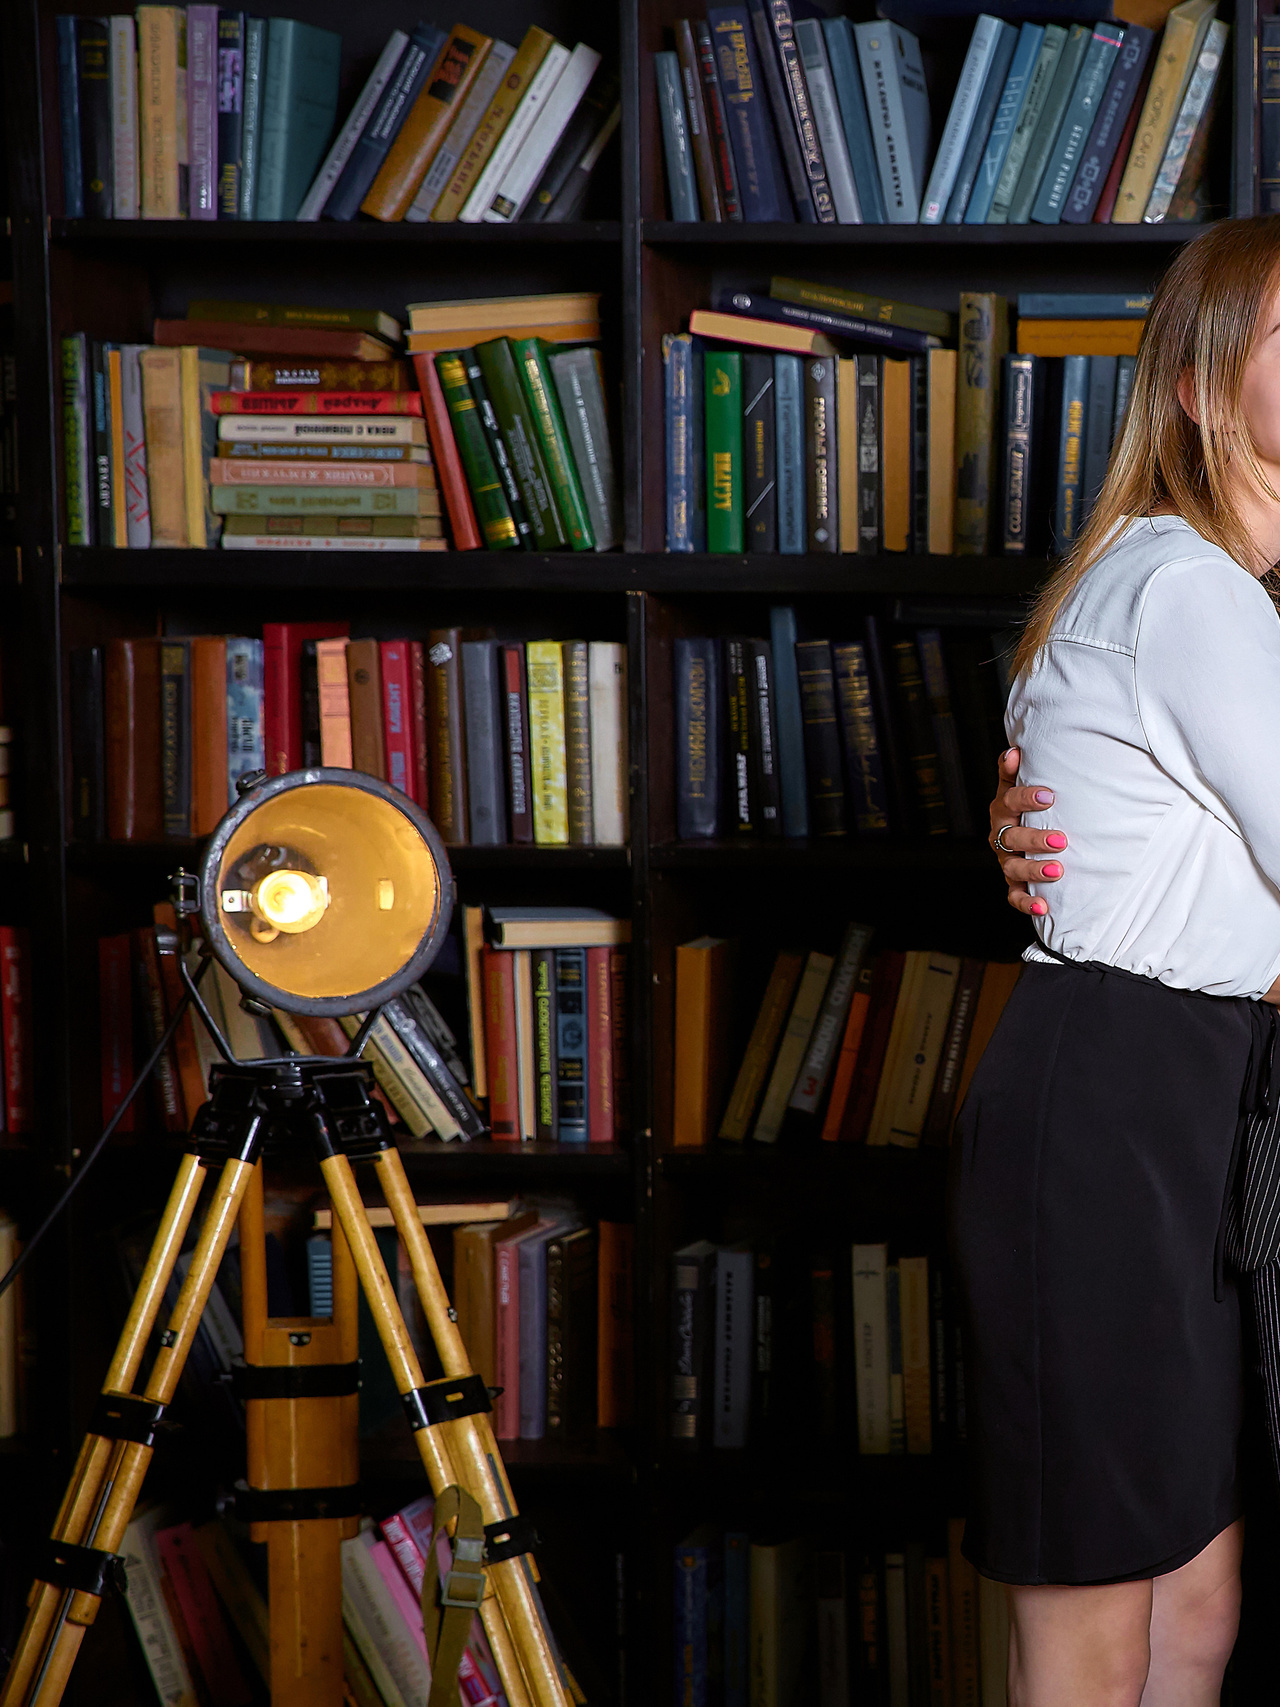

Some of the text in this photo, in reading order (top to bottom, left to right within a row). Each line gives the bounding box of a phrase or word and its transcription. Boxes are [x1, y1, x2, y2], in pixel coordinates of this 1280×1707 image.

[323, 396, 381, 409] Андрей
[294, 424, 395, 436] ЯВКА С ПОВИННОЙ
[537, 997, 552, 1125] ЛЮБИТЕЛЬ ШАМПАНСКОГО
